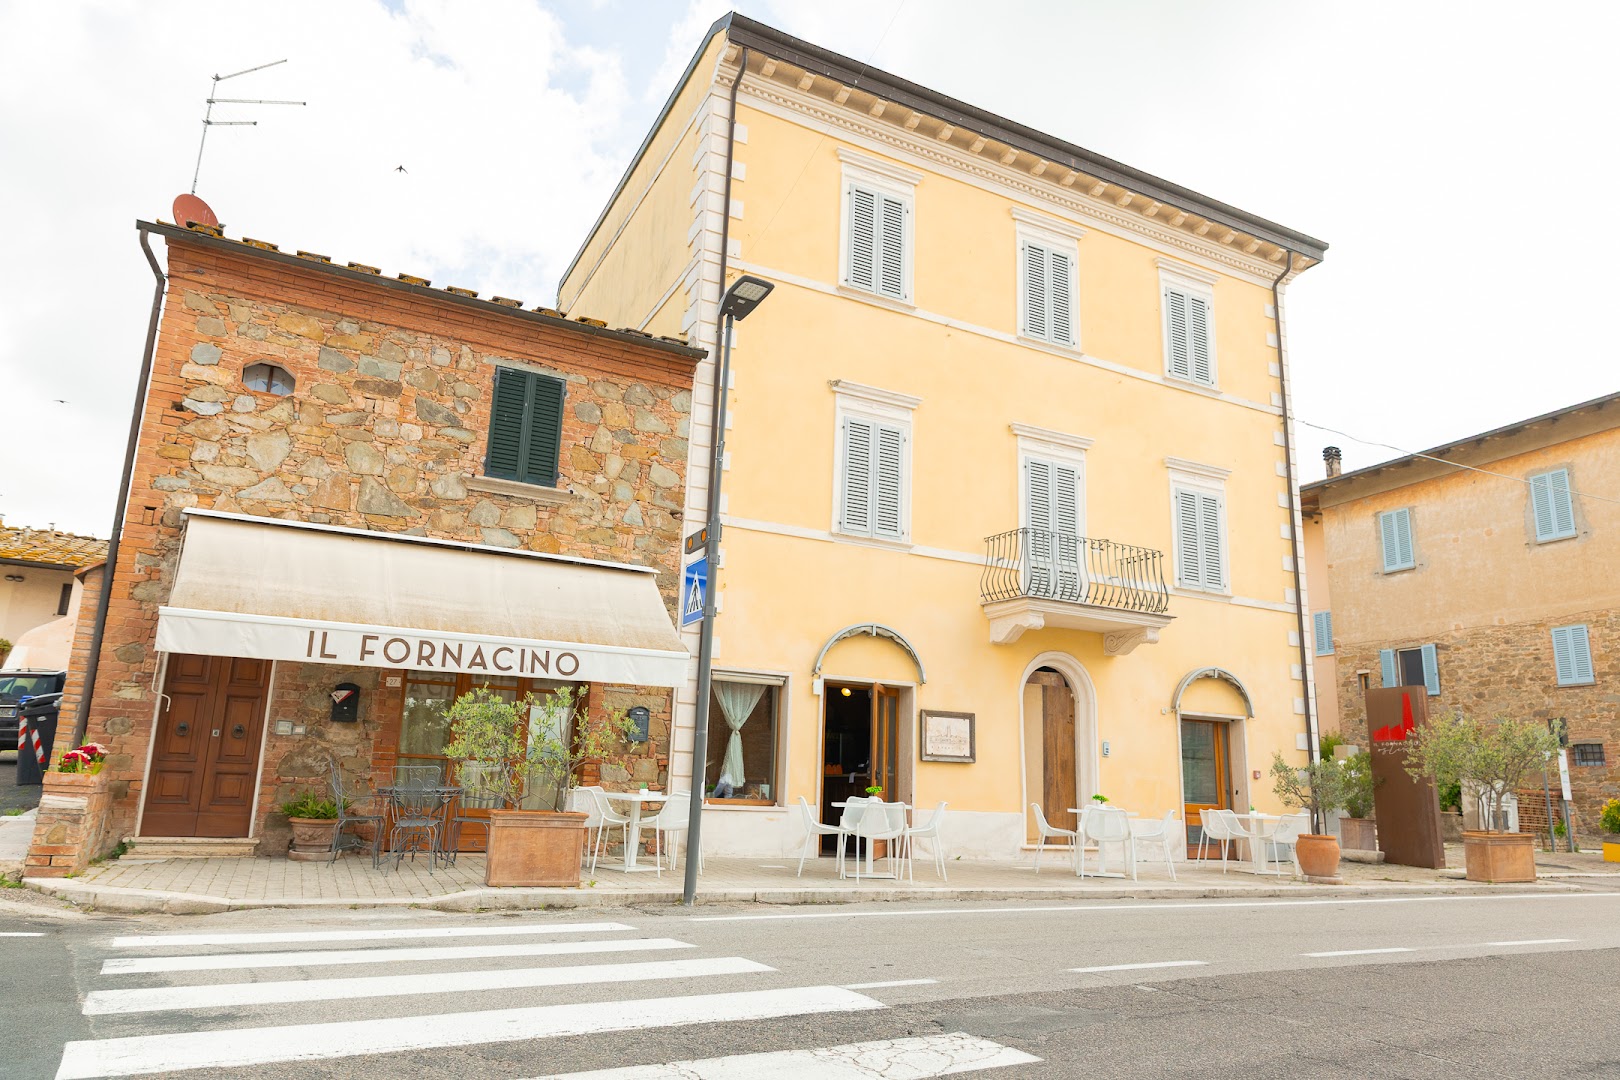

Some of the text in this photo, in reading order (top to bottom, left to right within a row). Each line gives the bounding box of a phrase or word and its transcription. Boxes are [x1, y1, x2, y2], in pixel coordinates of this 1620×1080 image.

[307, 630, 580, 677] IL FORNACINO
[389, 678, 398, 686] 27
